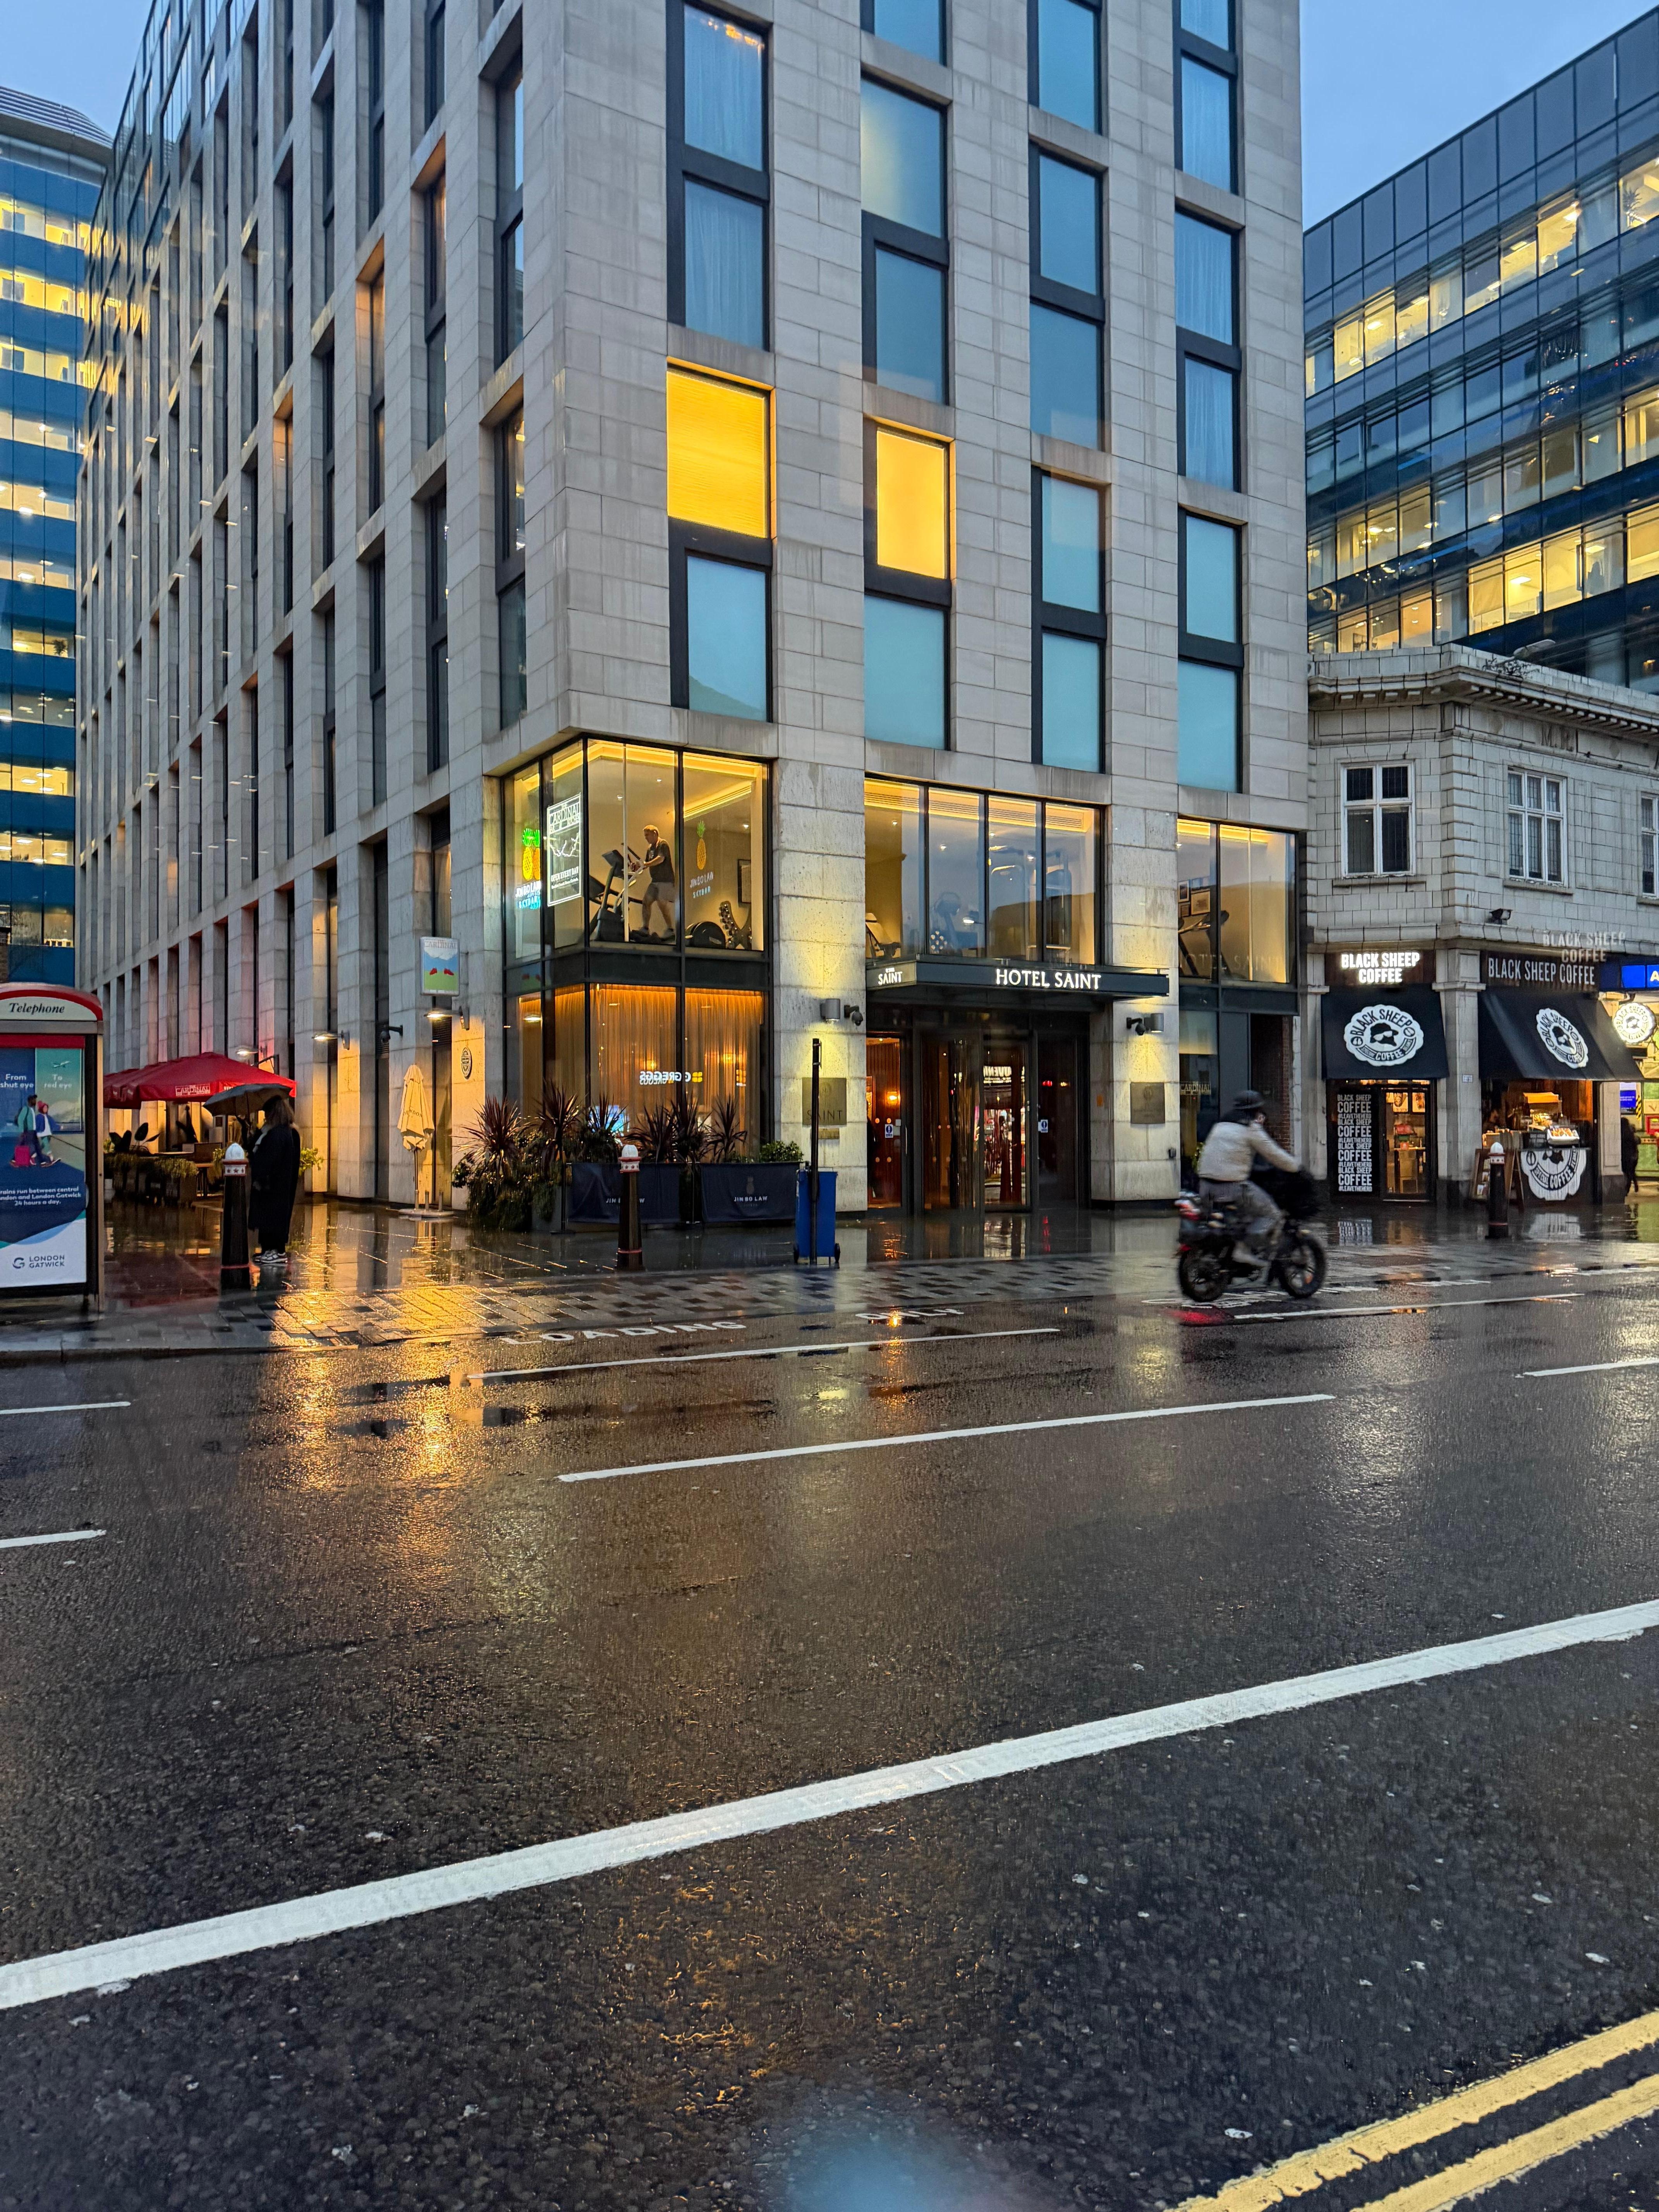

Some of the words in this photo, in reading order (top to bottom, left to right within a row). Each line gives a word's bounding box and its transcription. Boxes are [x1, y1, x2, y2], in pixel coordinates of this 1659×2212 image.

[550, 802, 580, 825] CARDINAL
[551, 872, 560, 882] OPEN
[704, 871, 713, 883] LAW
[1341, 953, 1379, 968] BLACK
[1381, 952, 1420, 967] SHEEP
[1561, 948, 1606, 963] COFFEE
[1359, 968, 1402, 983] COFFEE
[1488, 958, 1521, 980] BLACK
[1525, 960, 1556, 982] SHEEP
[1559, 964, 1595, 985] COFFEE
[878, 972, 903, 985] SAINT
[996, 969, 1050, 988] HOTEL
[1055, 972, 1101, 989] SAINT
[9, 1003, 65, 1015] Telephone
[1350, 1010, 1379, 1036] BLACK
[1379, 1009, 1413, 1028] SHEEP
[1540, 1013, 1554, 1038] BLACK
[1550, 1012, 1573, 1032] SHEEP
[1376, 1049, 1404, 1061] COFFEE
[176, 1085, 210, 1094] CARDINAL
[1338, 1101, 1371, 1113] COFFEE
[807, 1110, 843, 1121] SINT
[1338, 1126, 1371, 1137] COFFEE
[1338, 1150, 1372, 1161] COFFEE
[1338, 1174, 1372, 1185] COFFEE
[1550, 1166, 1573, 1188] COFFEE
[502, 1321, 746, 1345] LOADING
